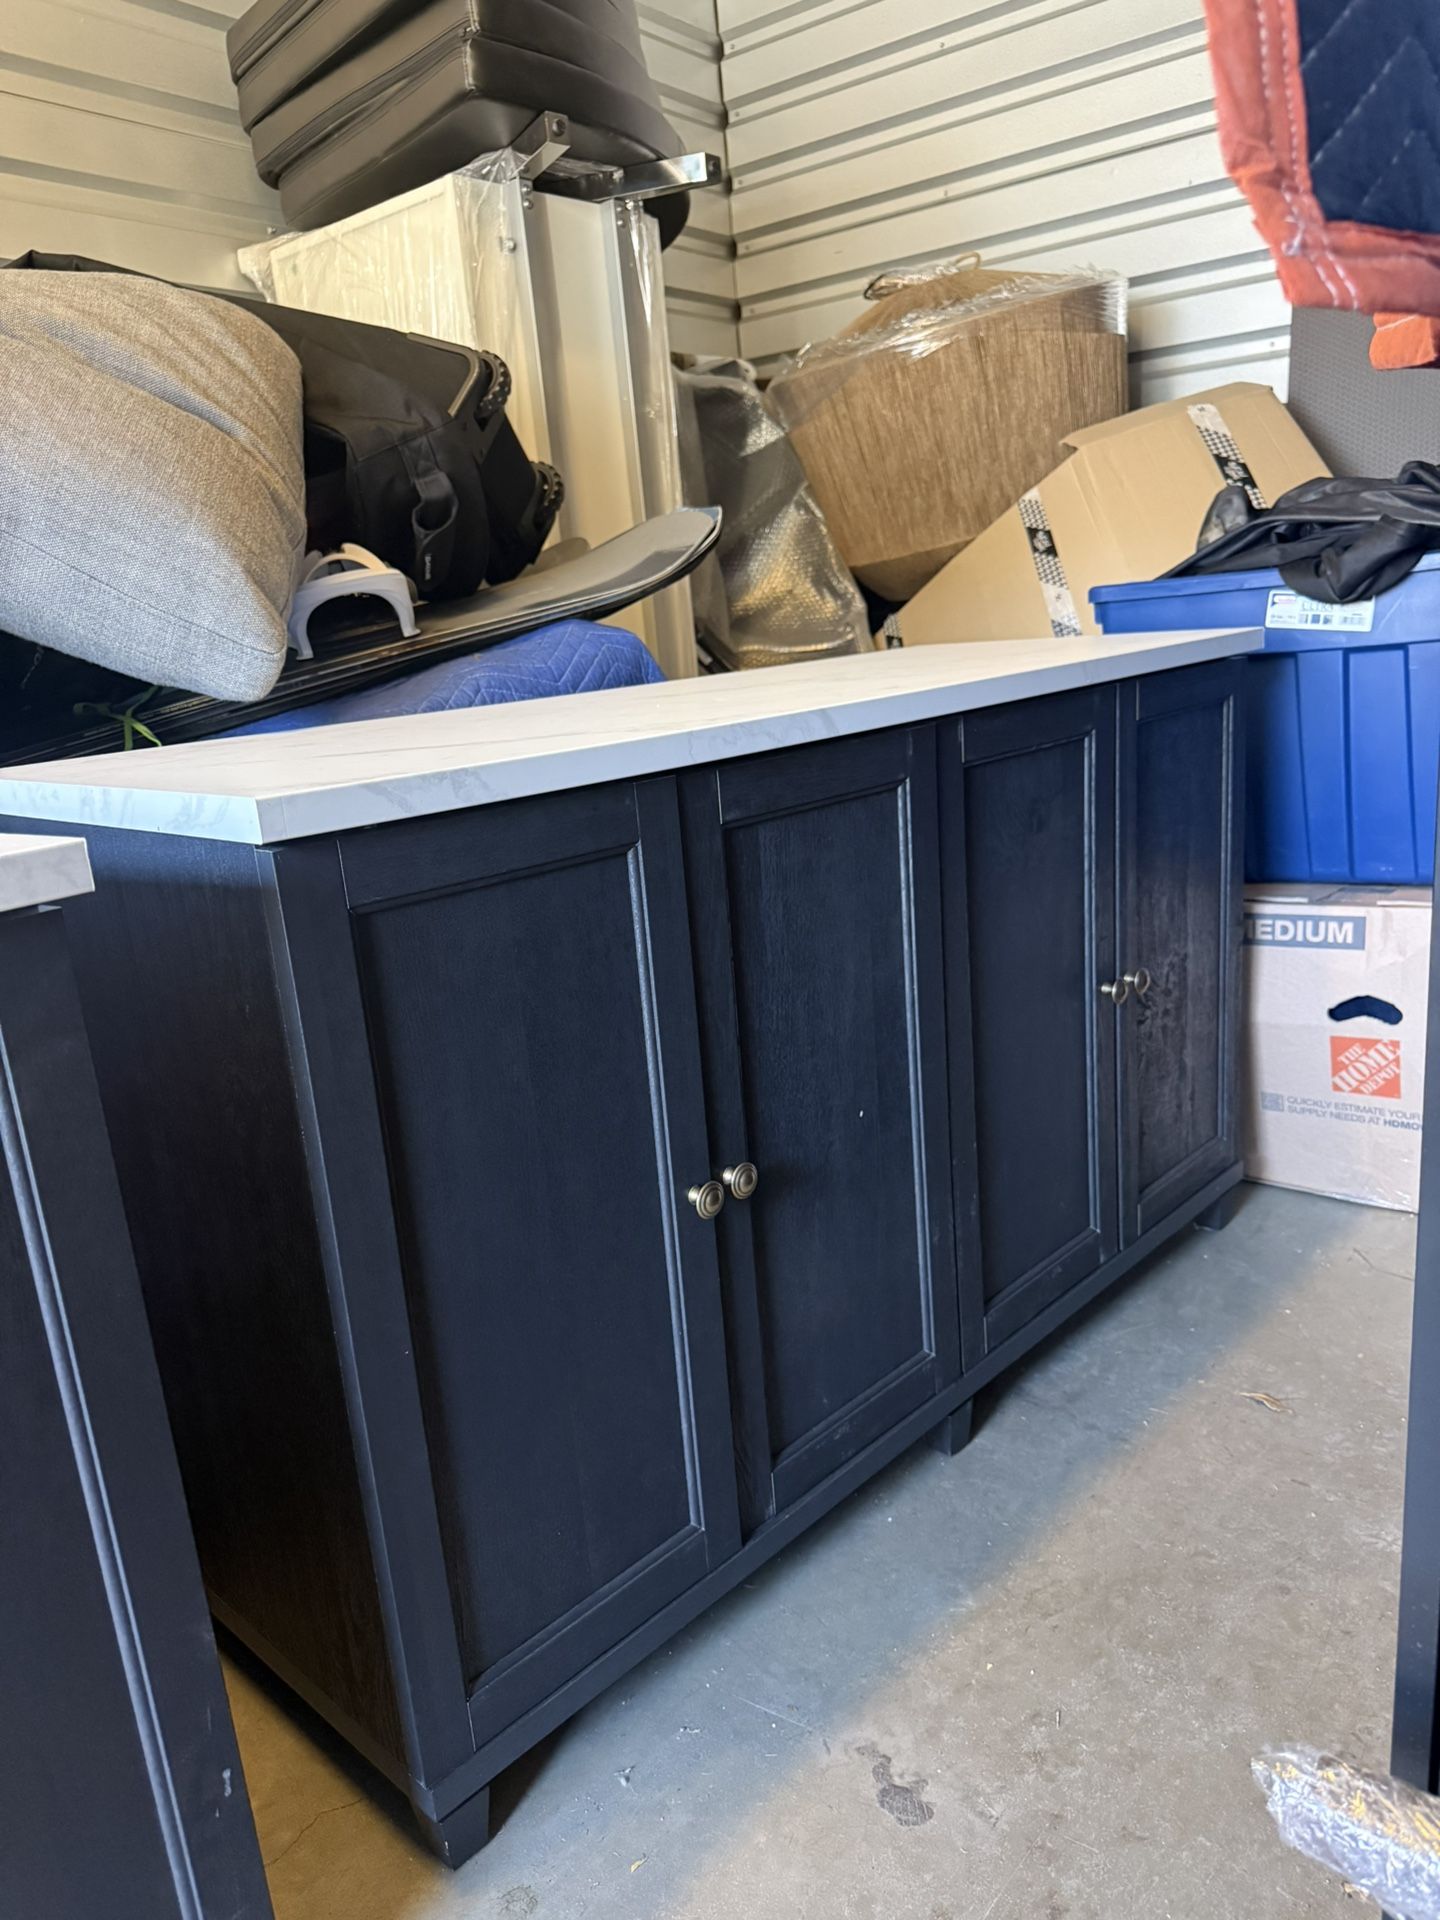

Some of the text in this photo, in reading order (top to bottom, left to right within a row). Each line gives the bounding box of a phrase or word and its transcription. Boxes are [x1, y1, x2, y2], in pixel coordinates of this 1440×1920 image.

[1332, 1040, 1400, 1092] HOME
[1337, 1042, 1362, 1065] THE
[1360, 1061, 1400, 1094] DEPOT
[1286, 1095, 1421, 1121] QUICKLY ESTIMATE YOUR
[1287, 1104, 1327, 1118] SUPPLY
[1329, 1111, 1366, 1124] NEEDS
[1367, 1116, 1382, 1126] AT
